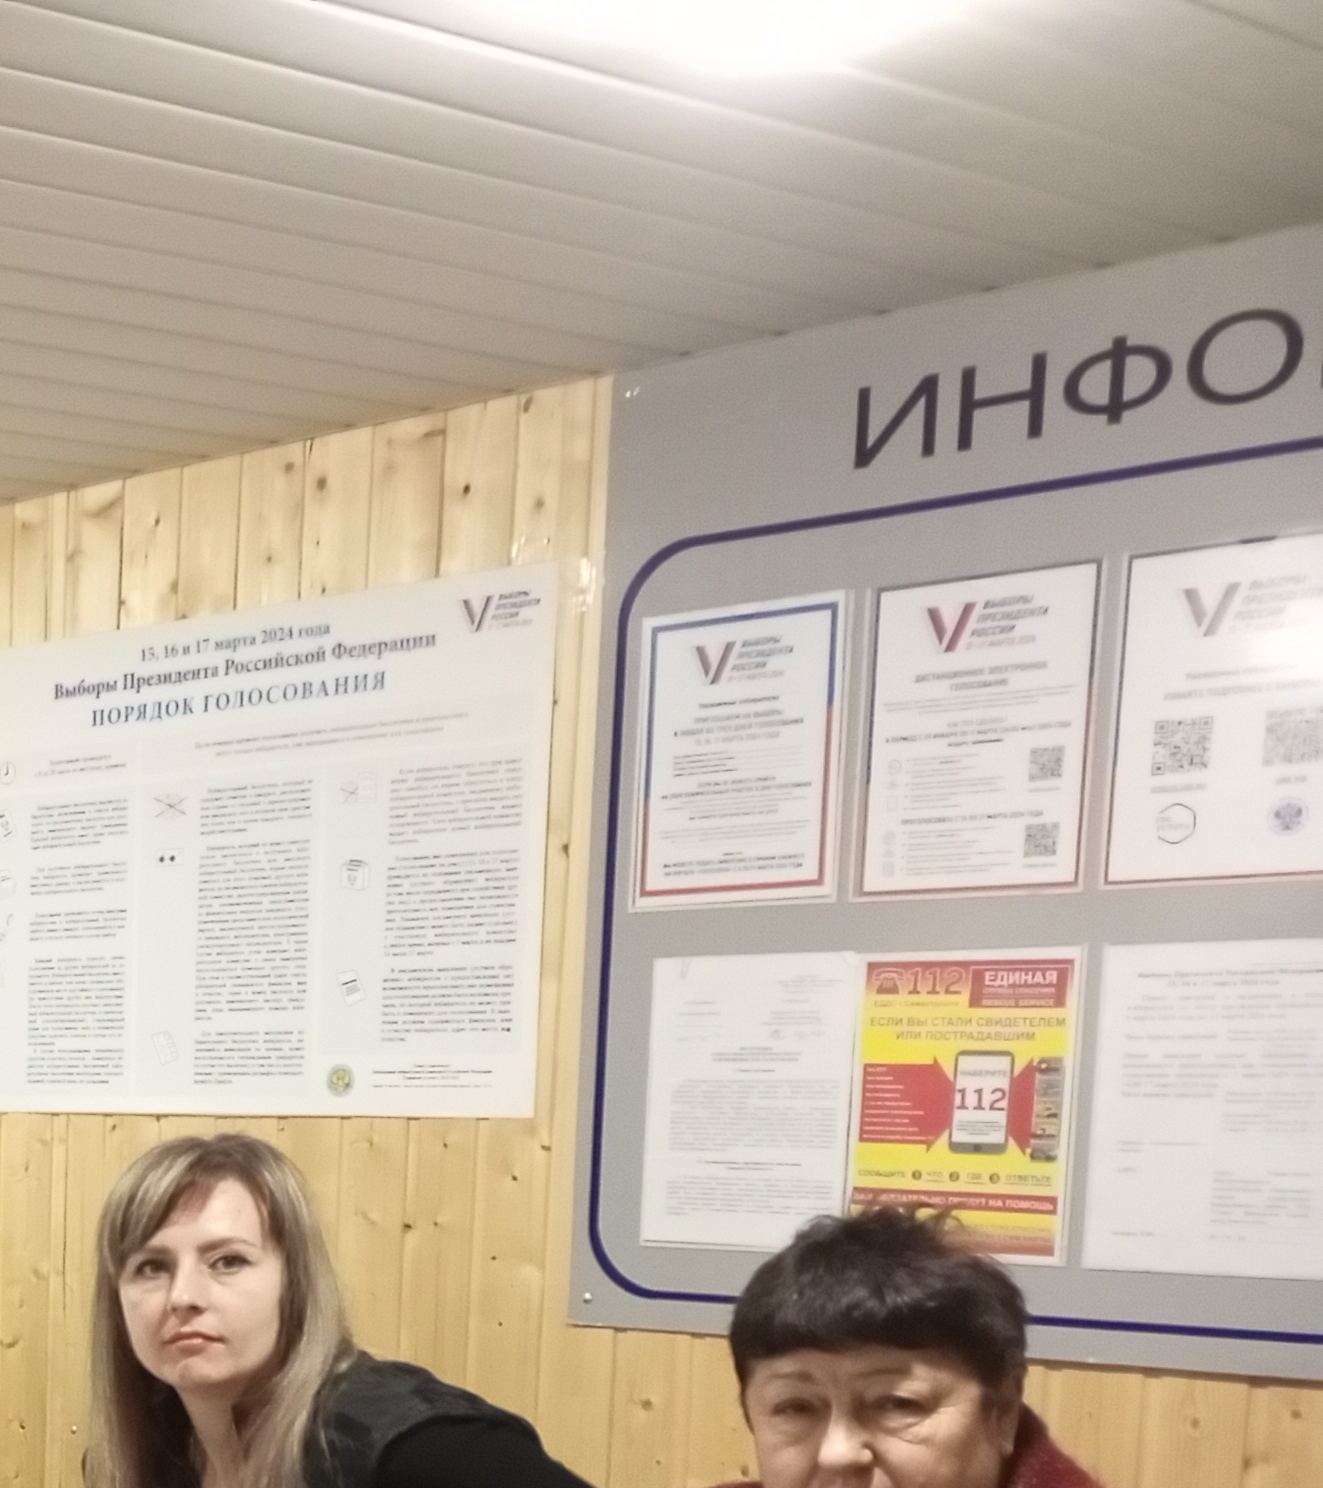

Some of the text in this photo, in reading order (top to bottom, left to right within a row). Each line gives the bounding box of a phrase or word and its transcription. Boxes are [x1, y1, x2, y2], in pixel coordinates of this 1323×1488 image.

[853, 308, 1323, 470] ИНФО
[140, 621, 331, 663] 15, 16 и 17 марта 2024 года
[53, 632, 436, 701] Выборы Президента Российской Федерации
[91, 670, 388, 728] ПОРЯДОК ГОЛОСОВАНИЯ
[907, 967, 965, 995] 112
[984, 971, 1058, 986] ЕДИНАЯ
[870, 1017, 1067, 1028] ЕСЛИ ВЫ СТАЛИ СВИДЕТЕЛЕМ
[896, 1031, 1036, 1041] ИЛИ ПОСТРАДАВШИМ
[956, 1087, 1007, 1112] 112
[988, 1198, 1003, 1208] НА
